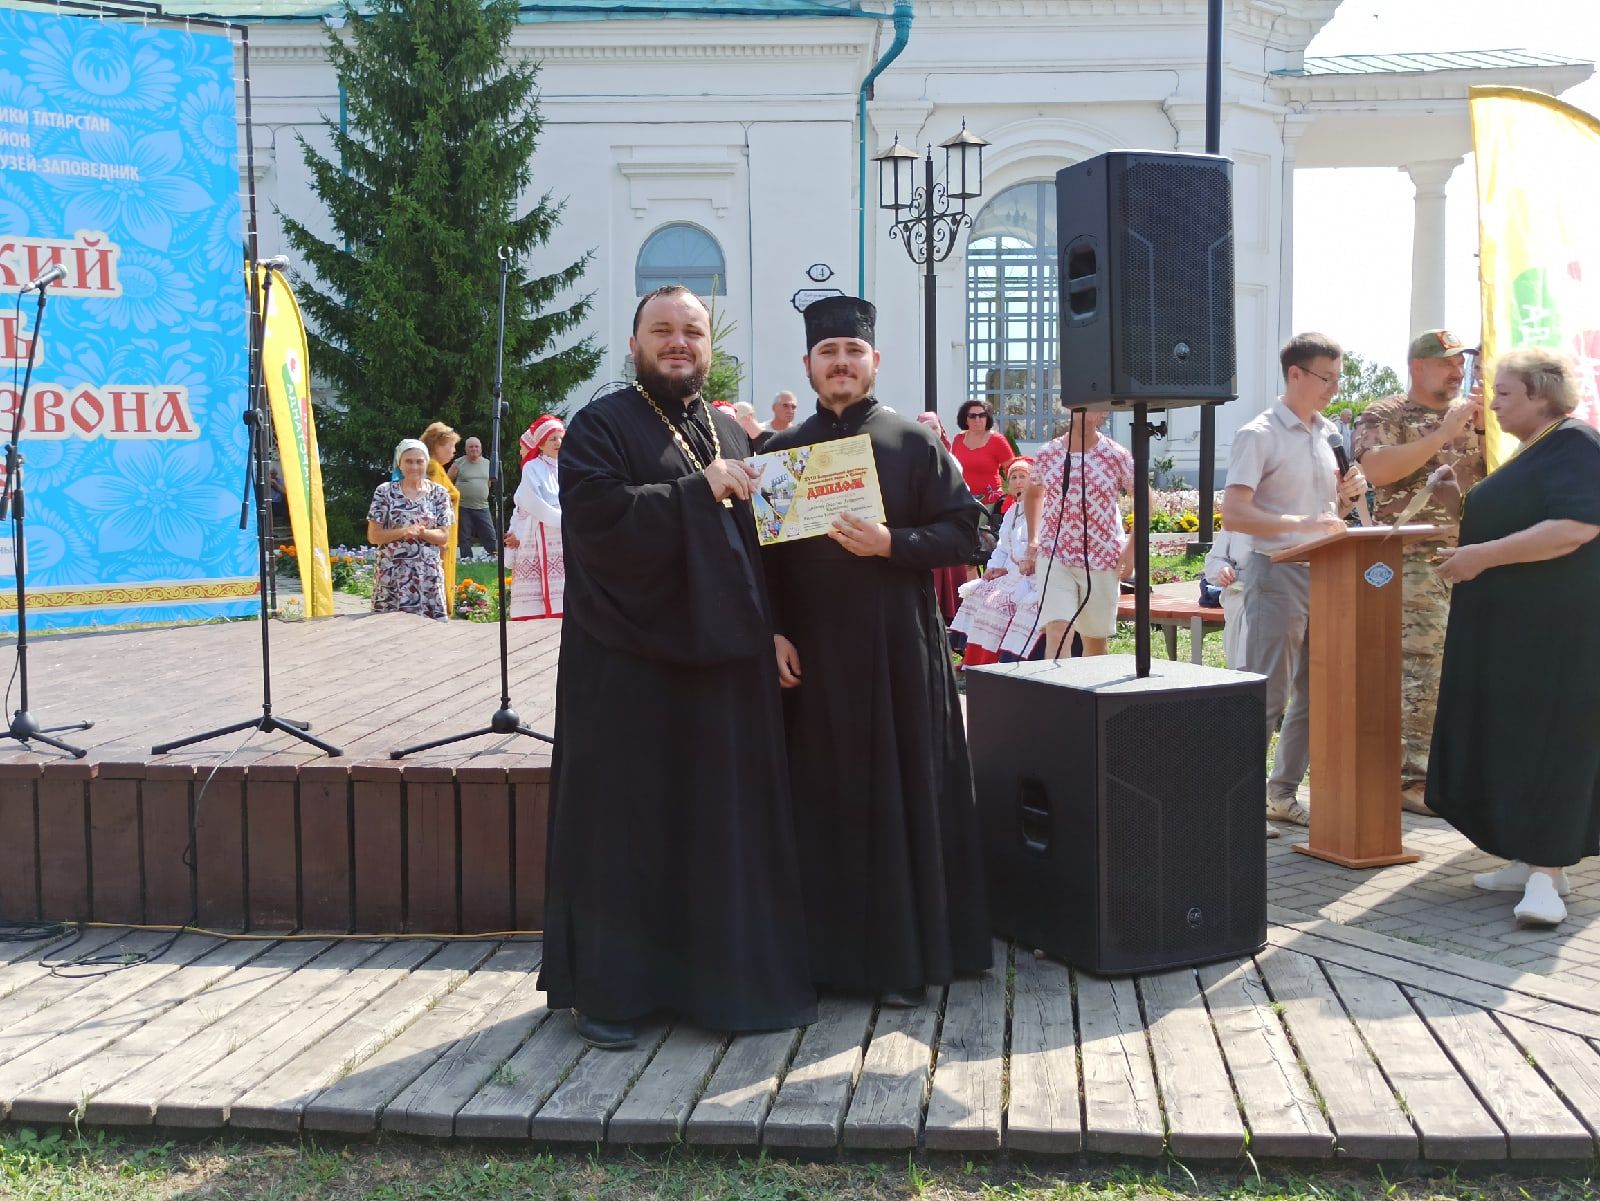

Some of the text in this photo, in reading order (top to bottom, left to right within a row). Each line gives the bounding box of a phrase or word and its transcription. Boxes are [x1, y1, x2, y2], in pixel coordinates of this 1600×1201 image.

[32, 110, 110, 132] ТАТАРСТАН
[0, 389, 193, 434] ЗВОНА
[807, 477, 865, 500] ДИПЛОМ
